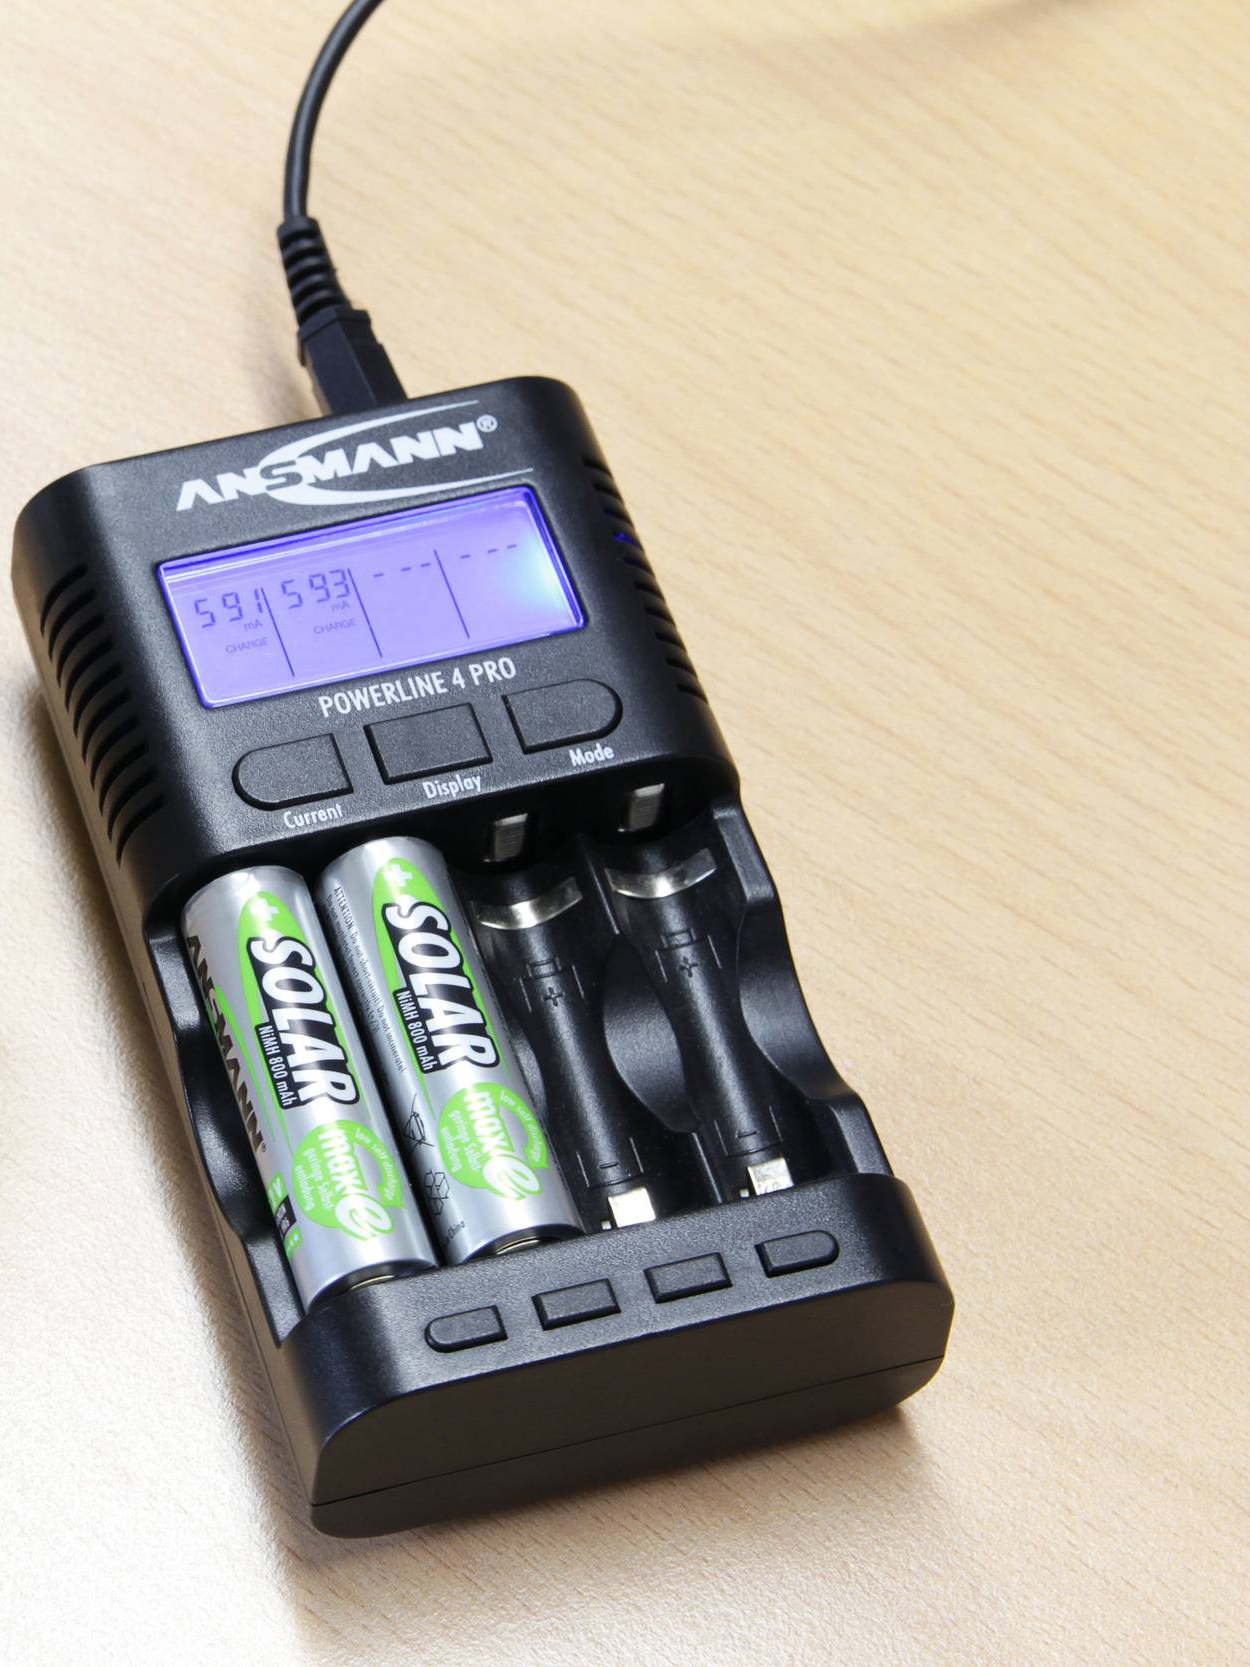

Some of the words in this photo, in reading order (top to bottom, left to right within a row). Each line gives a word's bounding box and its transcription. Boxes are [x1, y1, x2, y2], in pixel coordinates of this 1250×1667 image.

[194, 588, 263, 629] 591
[280, 569, 350, 609] 593
[313, 618, 357, 634] CHARGE
[225, 637, 270, 654] CHARGE
[318, 672, 448, 717] POWERLINE
[452, 664, 467, 690] 4
[469, 656, 518, 683] PRO
[569, 744, 615, 767] Mode
[422, 773, 483, 799] Display
[283, 803, 343, 829] Current
[387, 902, 497, 1066] SOLAR
[396, 990, 419, 1020] NiMH
[251, 937, 357, 1102] SOLAR
[408, 1021, 428, 1044] 800
[259, 1026, 281, 1055] NiMH
[269, 1056, 288, 1079] 800
[416, 1045, 438, 1071] mAh
[276, 1081, 298, 1106] mAh
